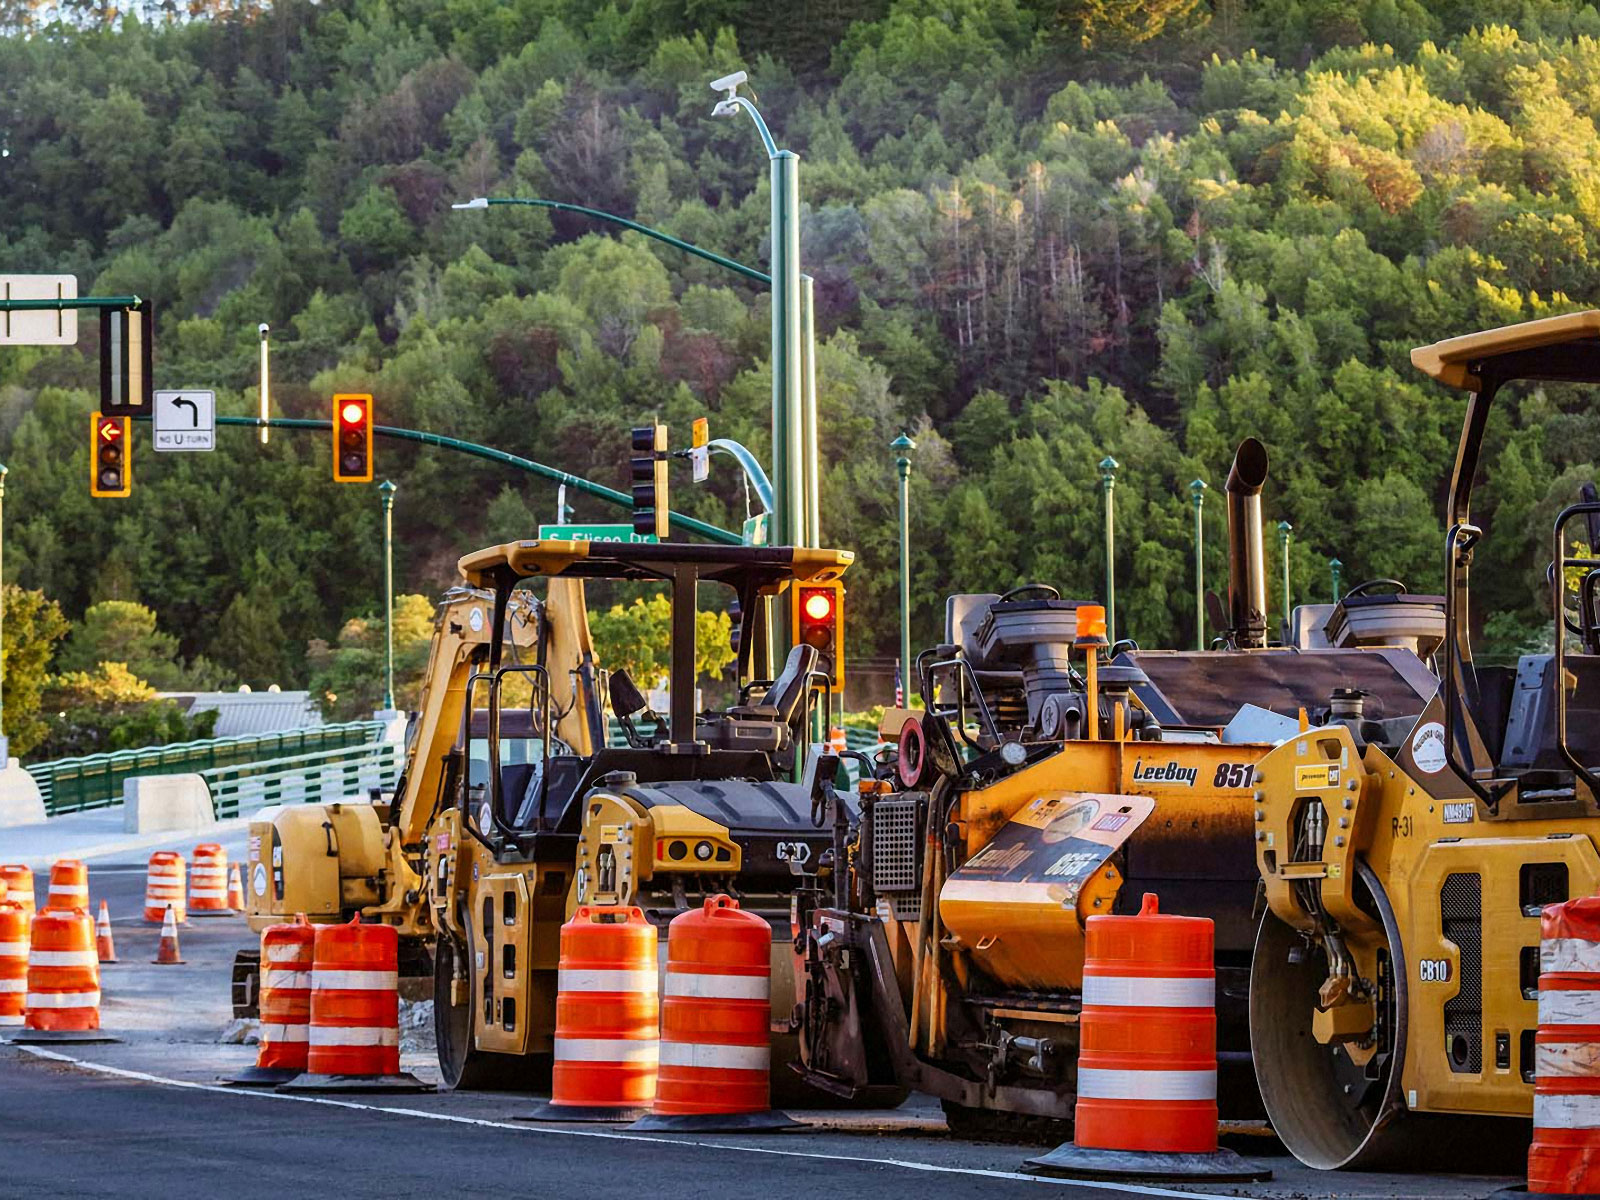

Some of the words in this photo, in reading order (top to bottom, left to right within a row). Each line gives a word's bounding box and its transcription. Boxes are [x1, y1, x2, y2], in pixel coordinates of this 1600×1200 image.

[174, 434, 183, 444] U
[1133, 760, 1198, 787] LeeBoy
[1213, 763, 1254, 788] 851
[1392, 815, 1413, 838] R-31
[1420, 960, 1447, 981] CB10
